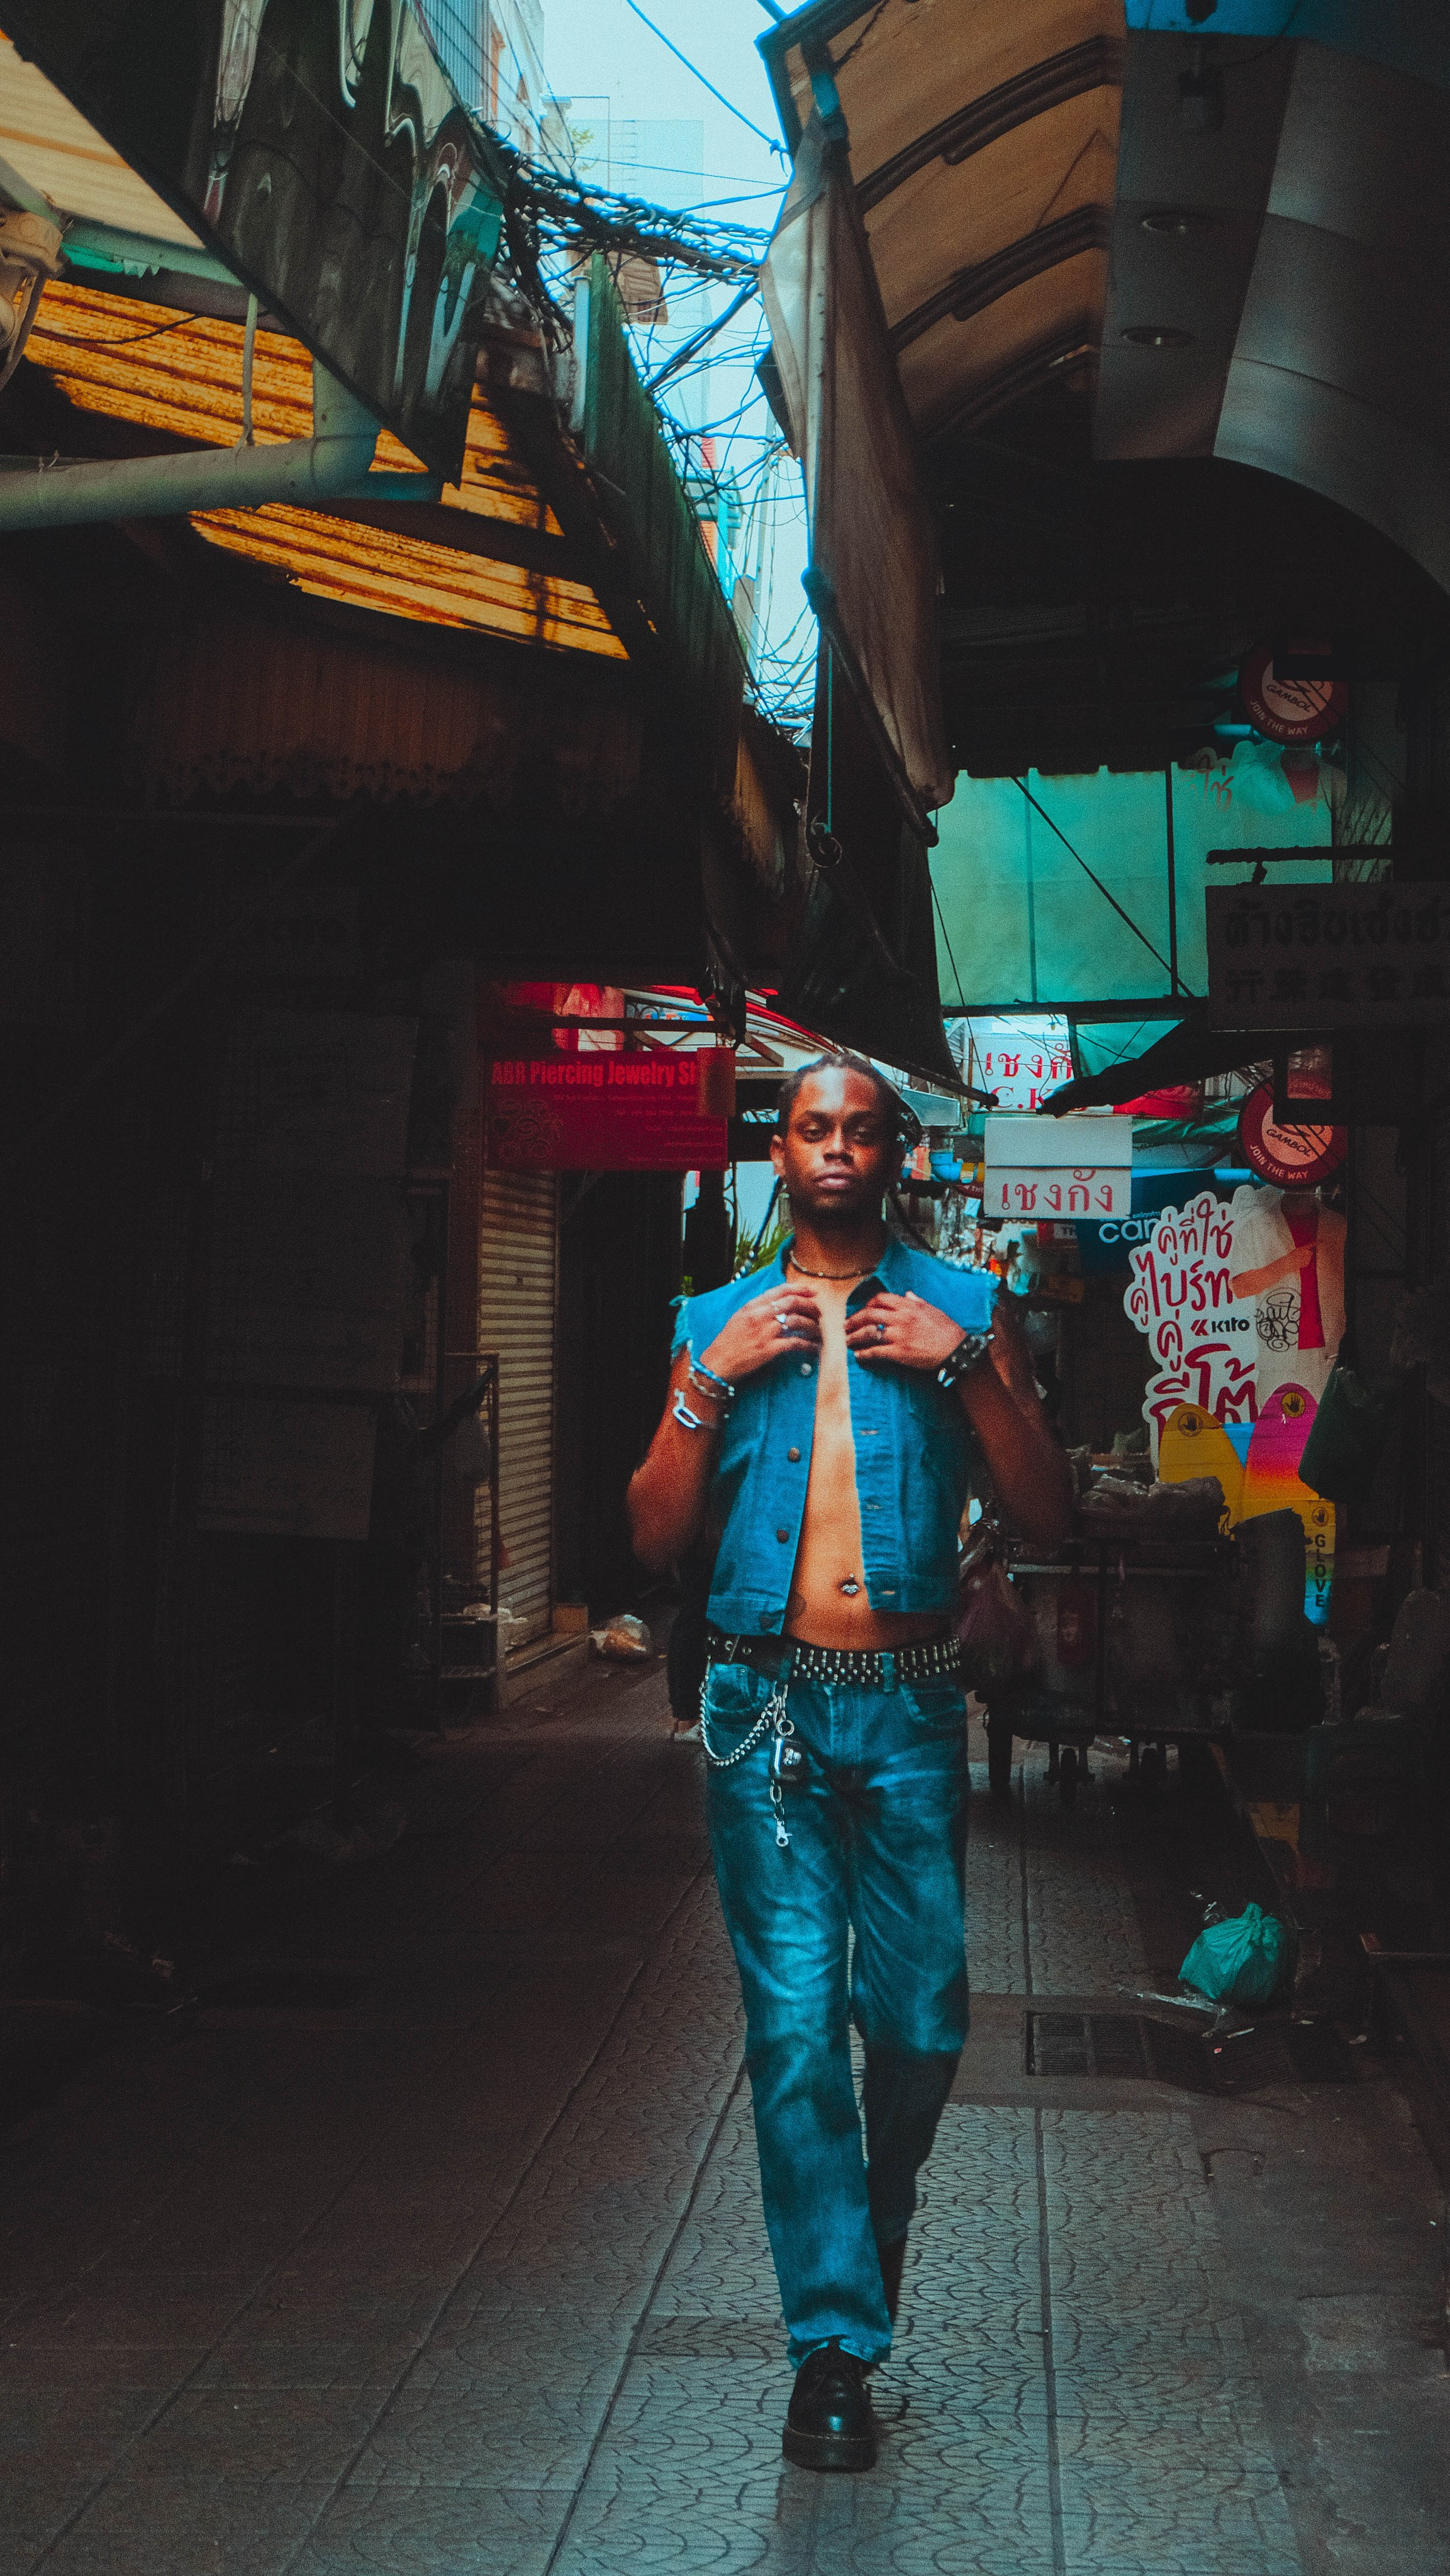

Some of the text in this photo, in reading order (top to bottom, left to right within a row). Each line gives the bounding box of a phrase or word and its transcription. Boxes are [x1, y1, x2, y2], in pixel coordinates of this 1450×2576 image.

[1267, 684, 1311, 712] GAMBOL
[1249, 699, 1308, 735] JOIN THE WAY
[530, 1060, 604, 1087] Piercing
[607, 1060, 675, 1087] Jewelry
[1266, 1129, 1310, 1157] GAMBOL
[1250, 1145, 1308, 1179] JOIN THE WAY
[1001, 1169, 1112, 1212] เชงกัง
[1314, 1534, 1327, 1607] GLOVE
